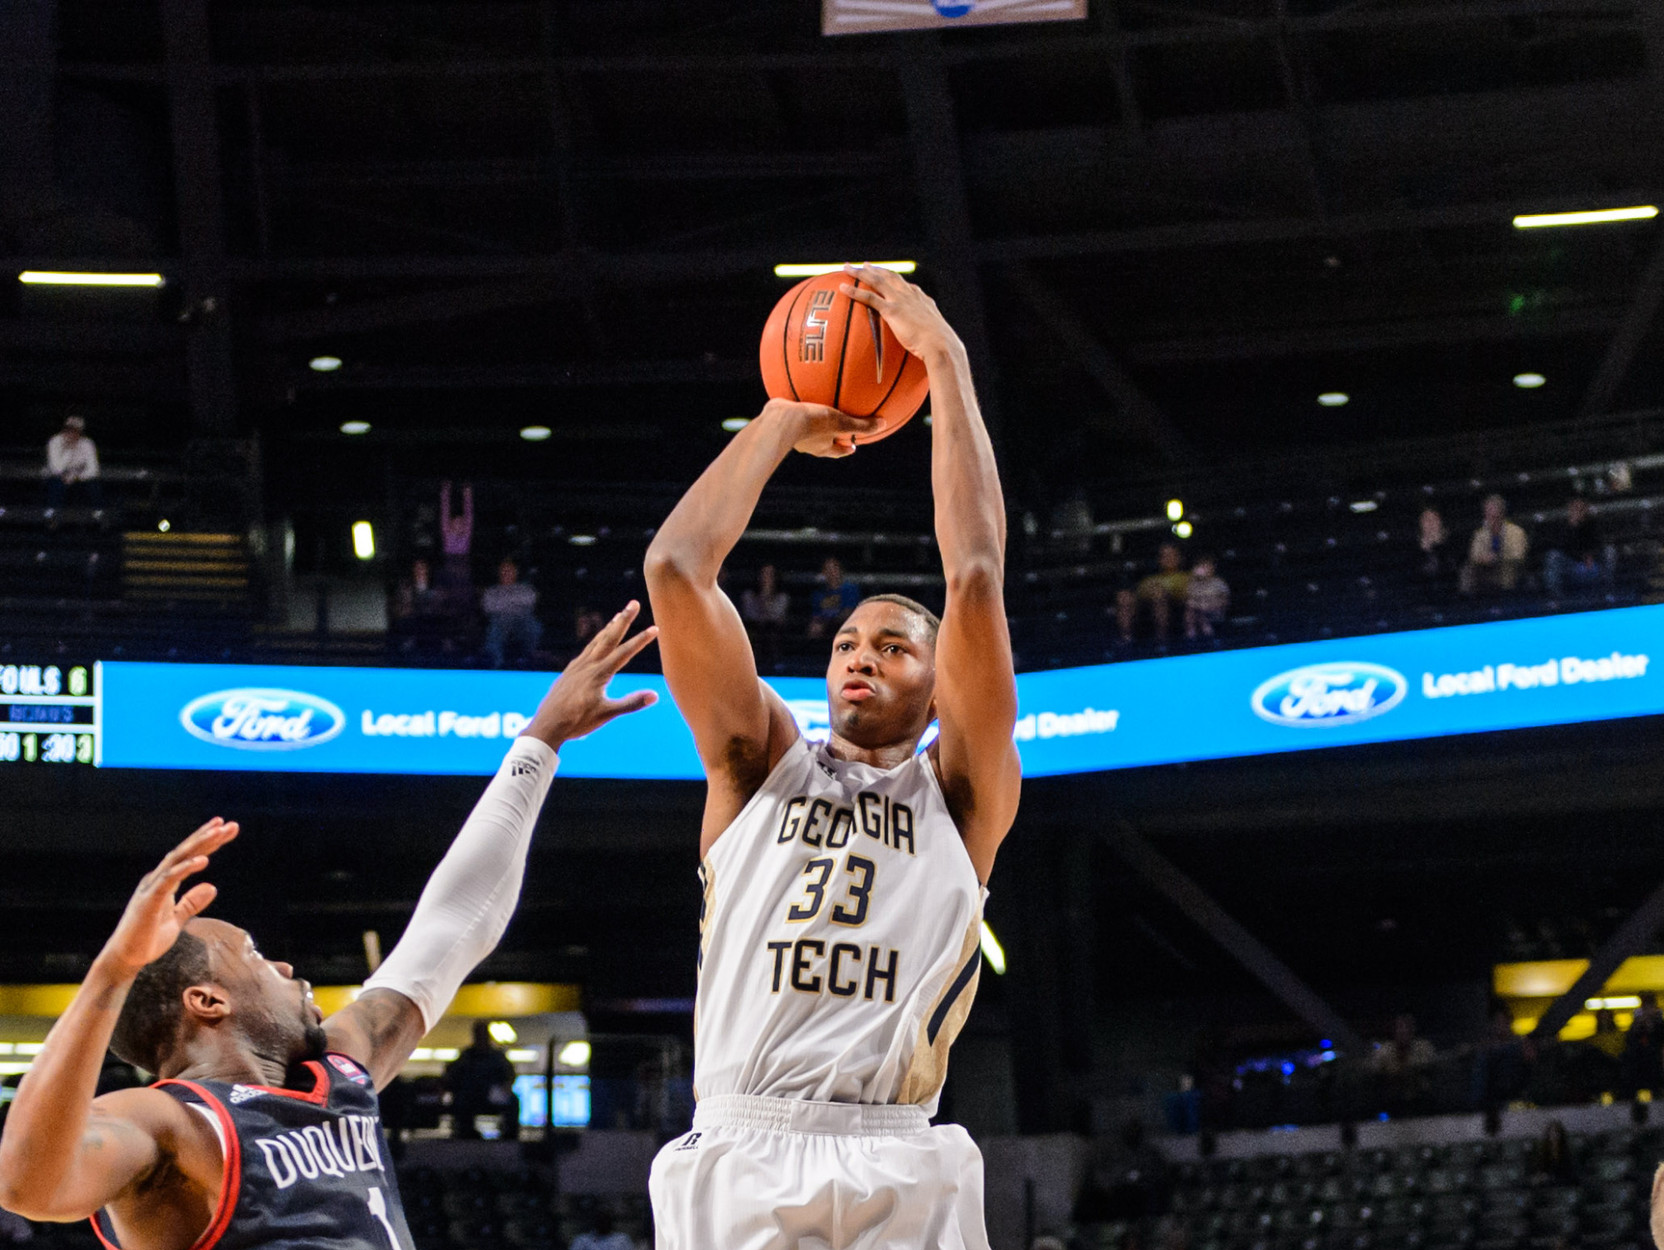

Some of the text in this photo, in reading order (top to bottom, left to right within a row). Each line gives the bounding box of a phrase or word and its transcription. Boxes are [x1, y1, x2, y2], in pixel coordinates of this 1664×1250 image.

[1279, 672, 1378, 718] Ford
[1422, 651, 1650, 699] Local Ford Dealer
[211, 697, 314, 742] Ford
[360, 709, 436, 738] Local
[436, 711, 501, 739] Ford
[1011, 707, 1120, 741] rd Dealer
[777, 790, 917, 857] GEOGIA
[784, 851, 878, 929] 33
[766, 938, 900, 1004] TECH
